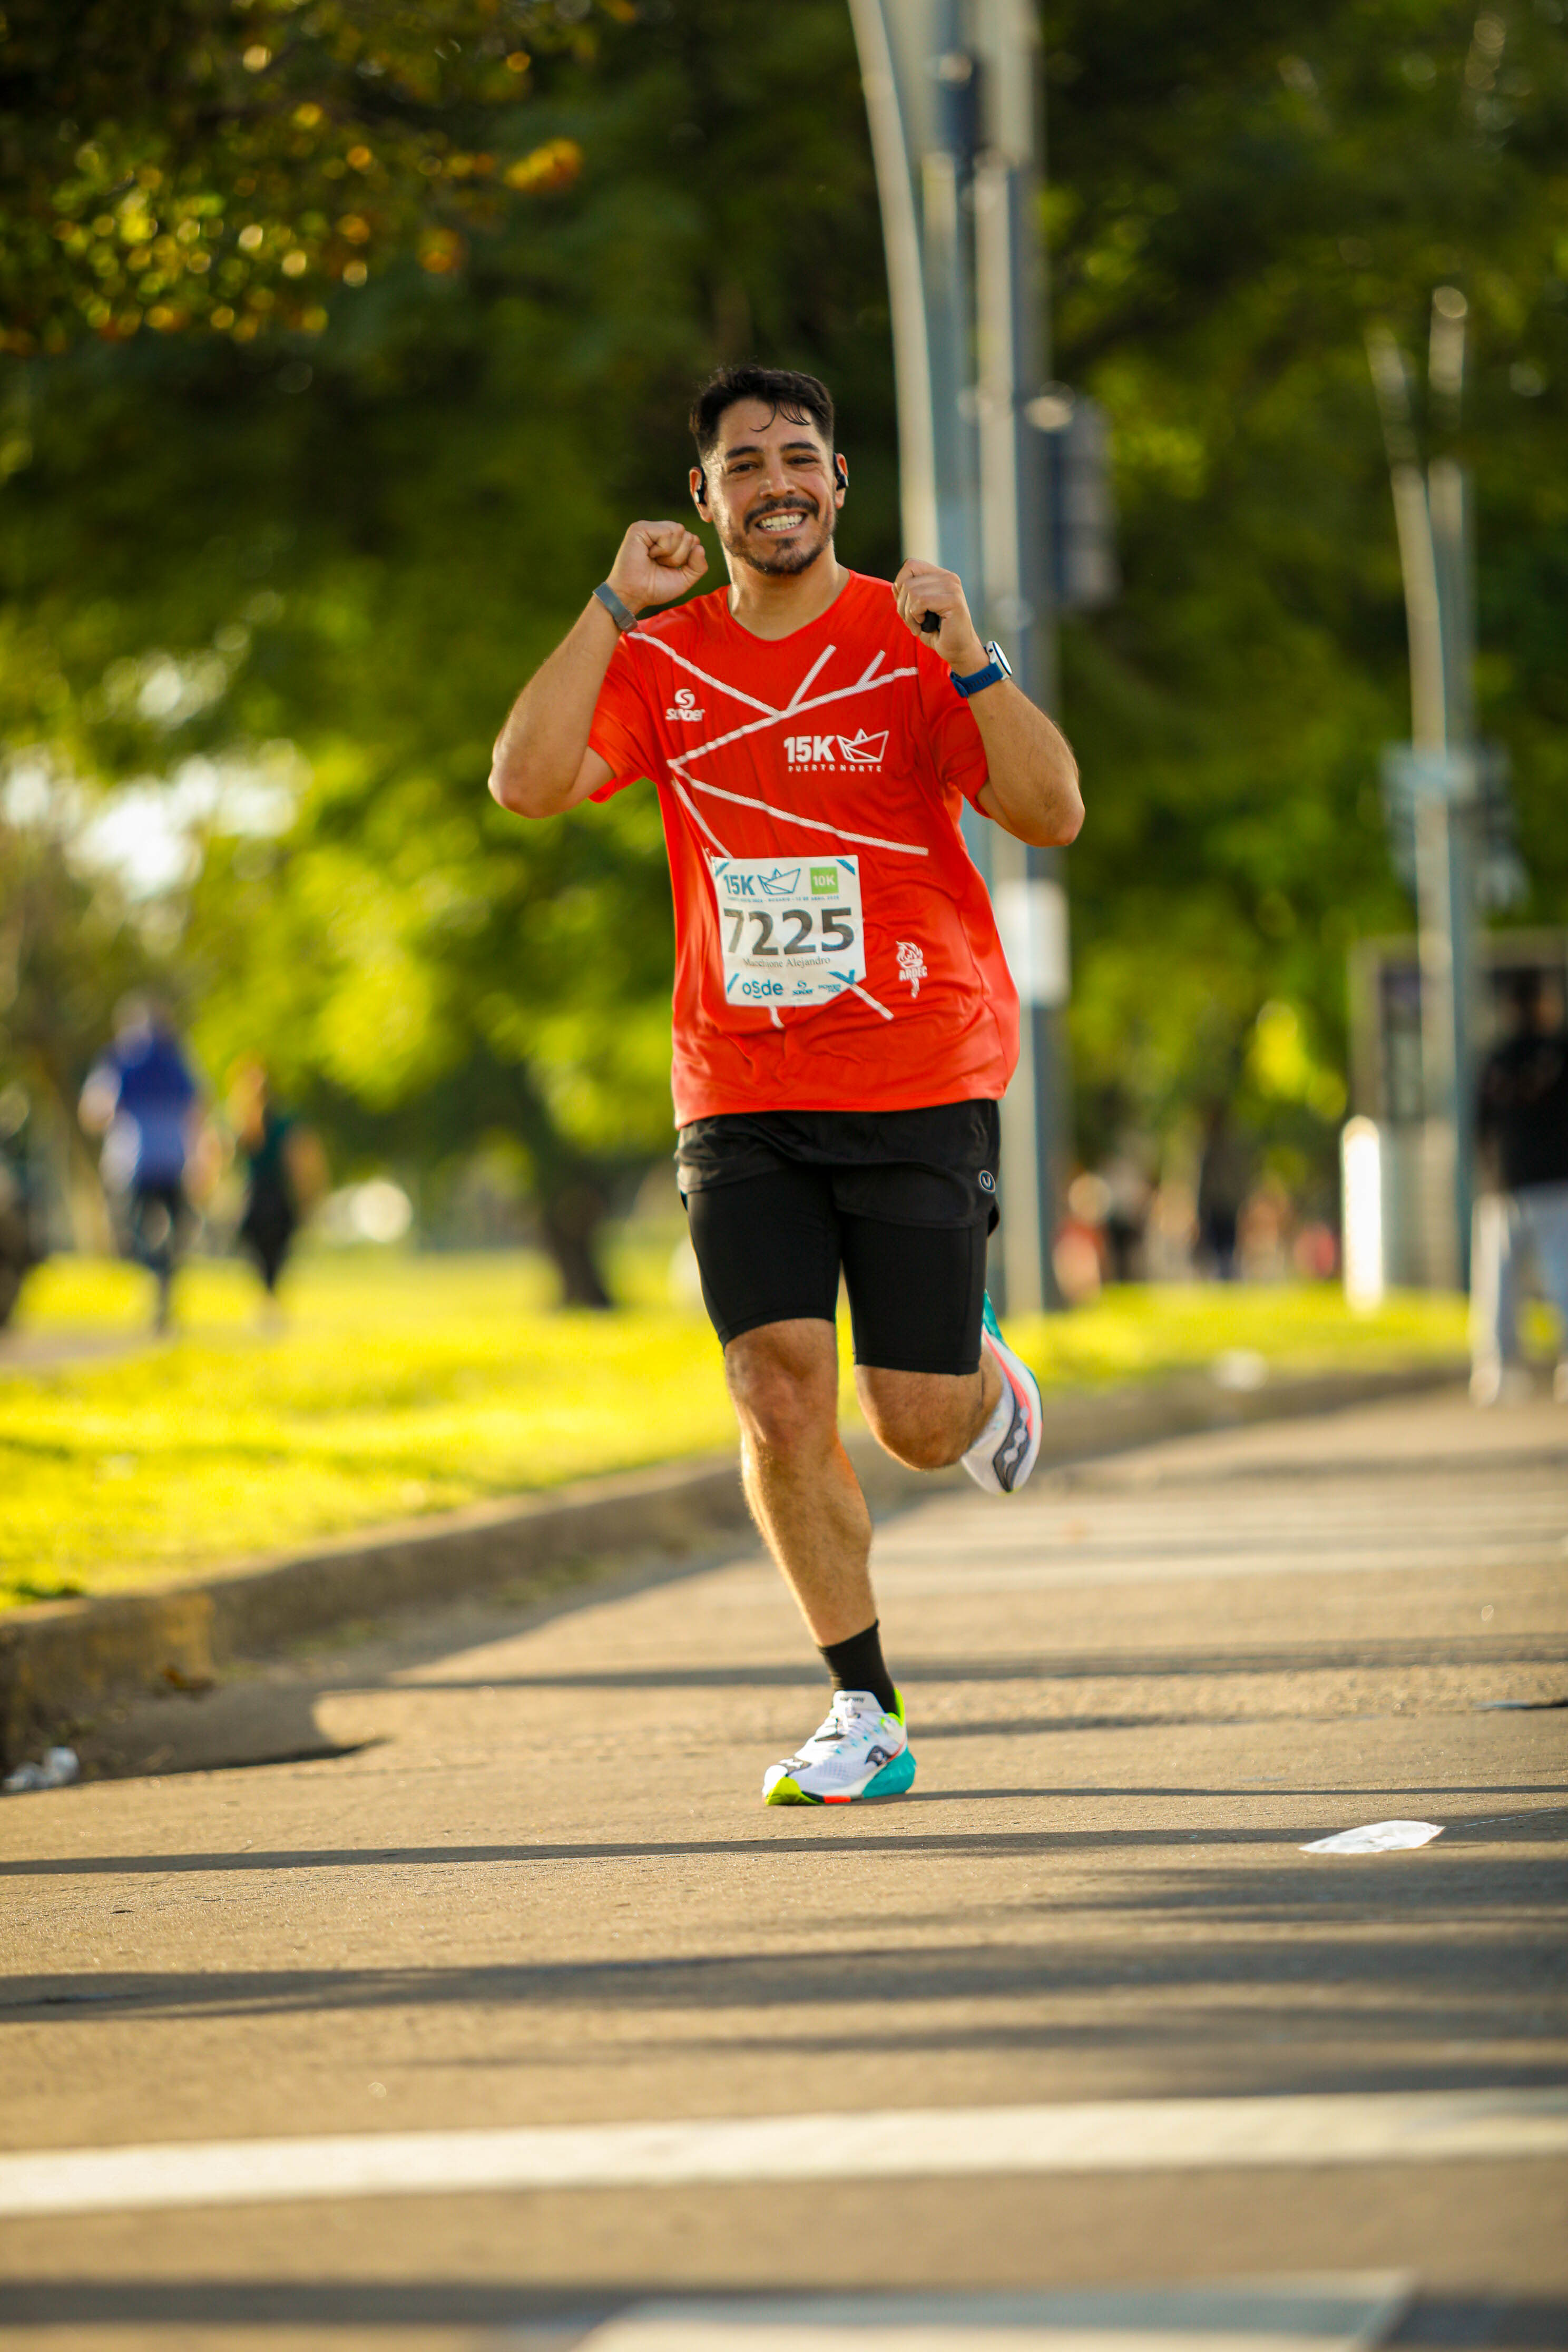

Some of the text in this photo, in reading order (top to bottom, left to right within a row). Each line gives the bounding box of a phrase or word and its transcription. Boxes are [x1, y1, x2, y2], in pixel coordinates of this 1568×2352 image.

[784, 736, 836, 763] 15K
[788, 765, 882, 773] PUERTO NORTE
[723, 873, 756, 895] 15K
[812, 874, 836, 886] 10K
[723, 907, 855, 955] 7225
[787, 955, 831, 968] Alejandro
[742, 978, 784, 998] osde
